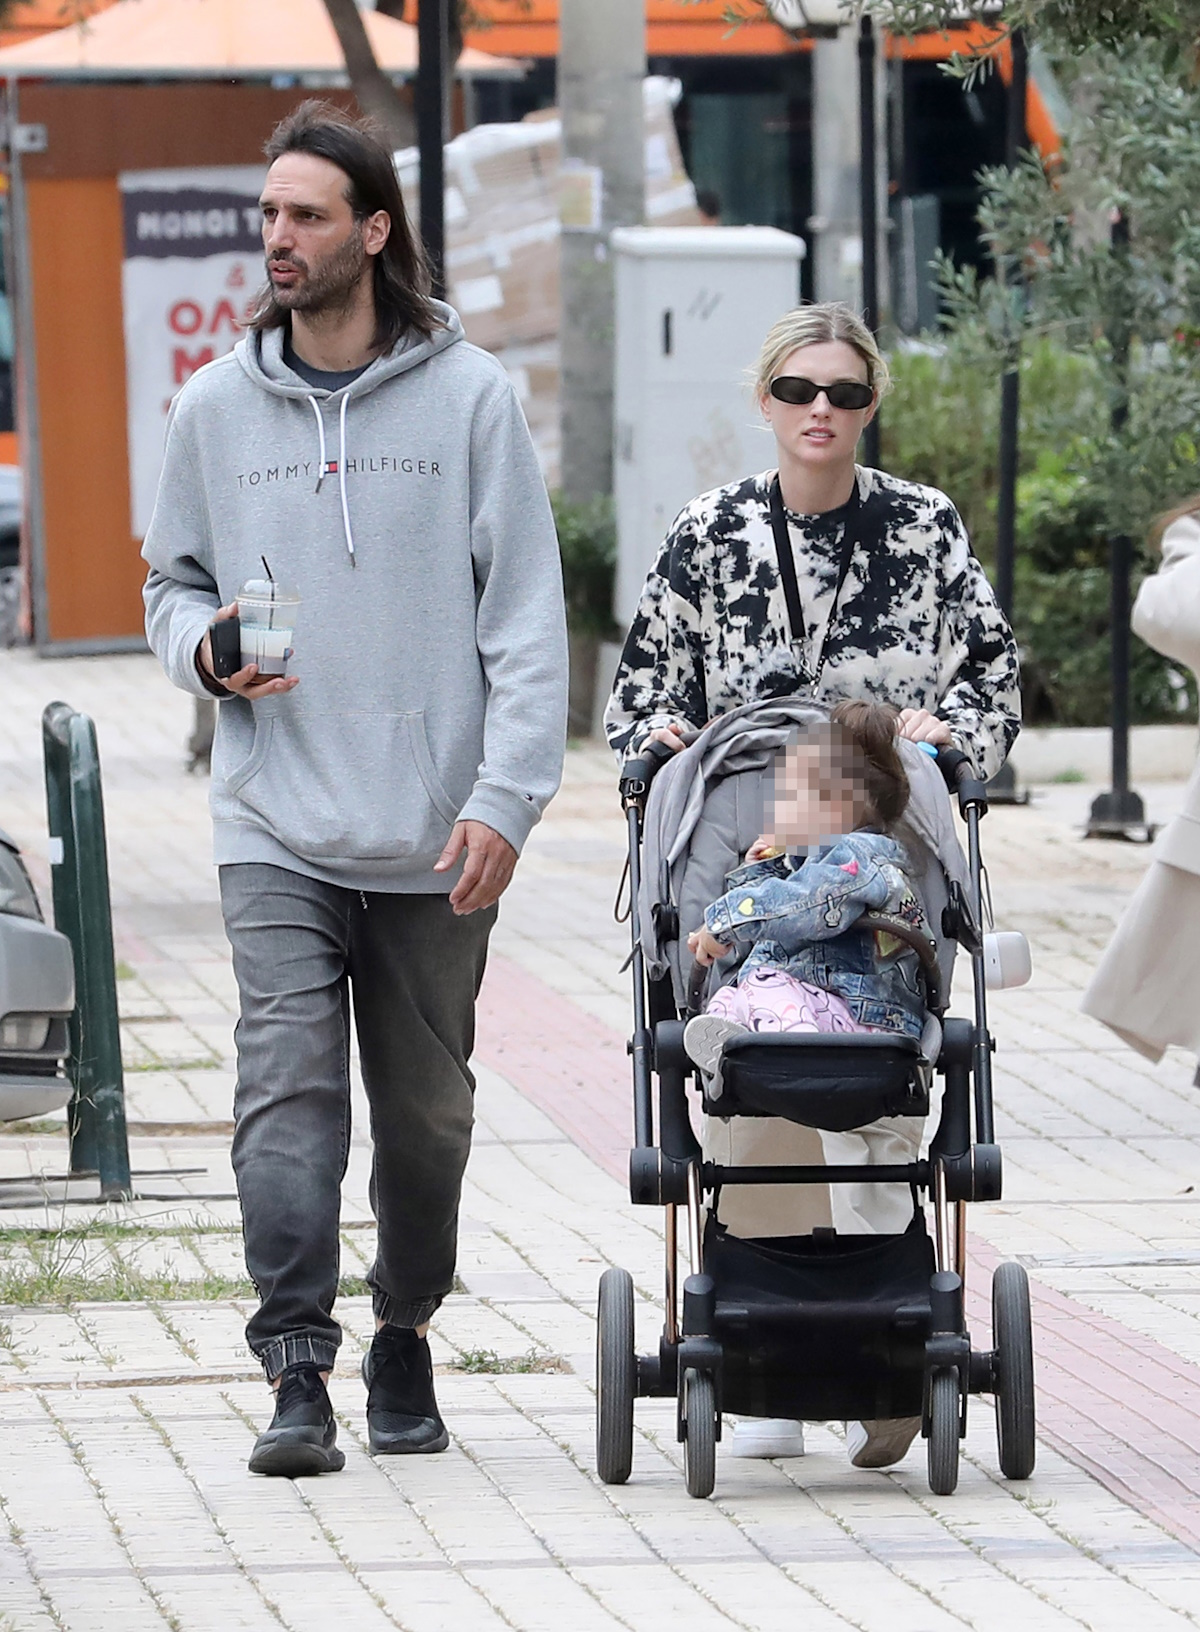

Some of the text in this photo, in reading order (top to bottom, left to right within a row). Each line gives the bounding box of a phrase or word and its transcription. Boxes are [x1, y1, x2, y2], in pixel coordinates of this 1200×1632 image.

[168, 299, 254, 335] ΟΛ
[237, 457, 442, 488] TOMMY HILFIGER
